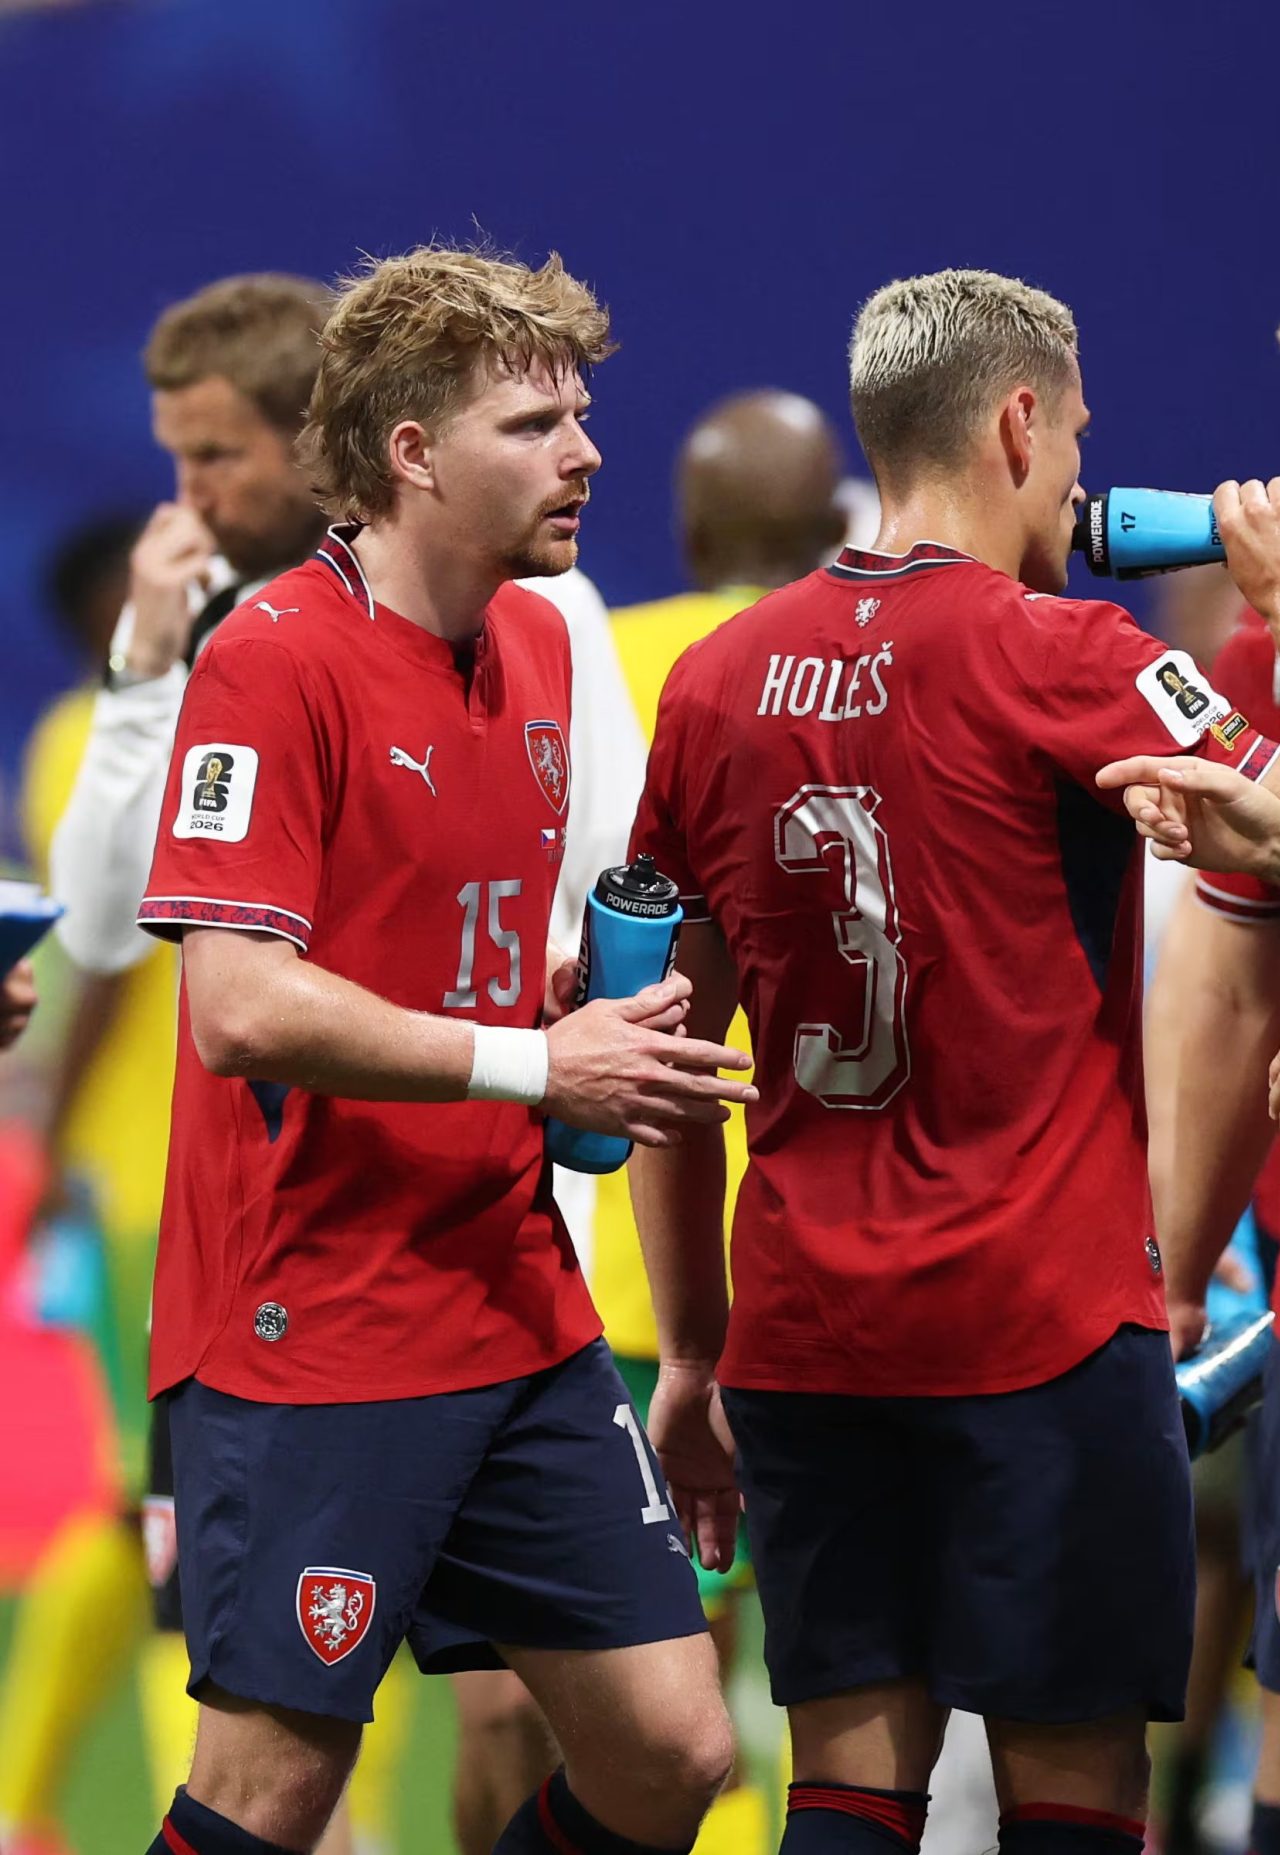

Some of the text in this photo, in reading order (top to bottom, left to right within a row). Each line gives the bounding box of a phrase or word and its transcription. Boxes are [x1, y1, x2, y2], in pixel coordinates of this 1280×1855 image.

[1090, 500, 1105, 563] POWERADE
[1121, 511, 1136, 533] 17
[757, 640, 894, 722] HOLEŠ
[1188, 699, 1204, 714] FIFA
[199, 798, 217, 808] FIFA
[190, 820, 224, 831] 2026
[606, 892, 669, 915] POWERADE
[443, 879, 522, 1008] 15
[774, 784, 910, 1110] 3
[612, 1403, 678, 1525] 1
